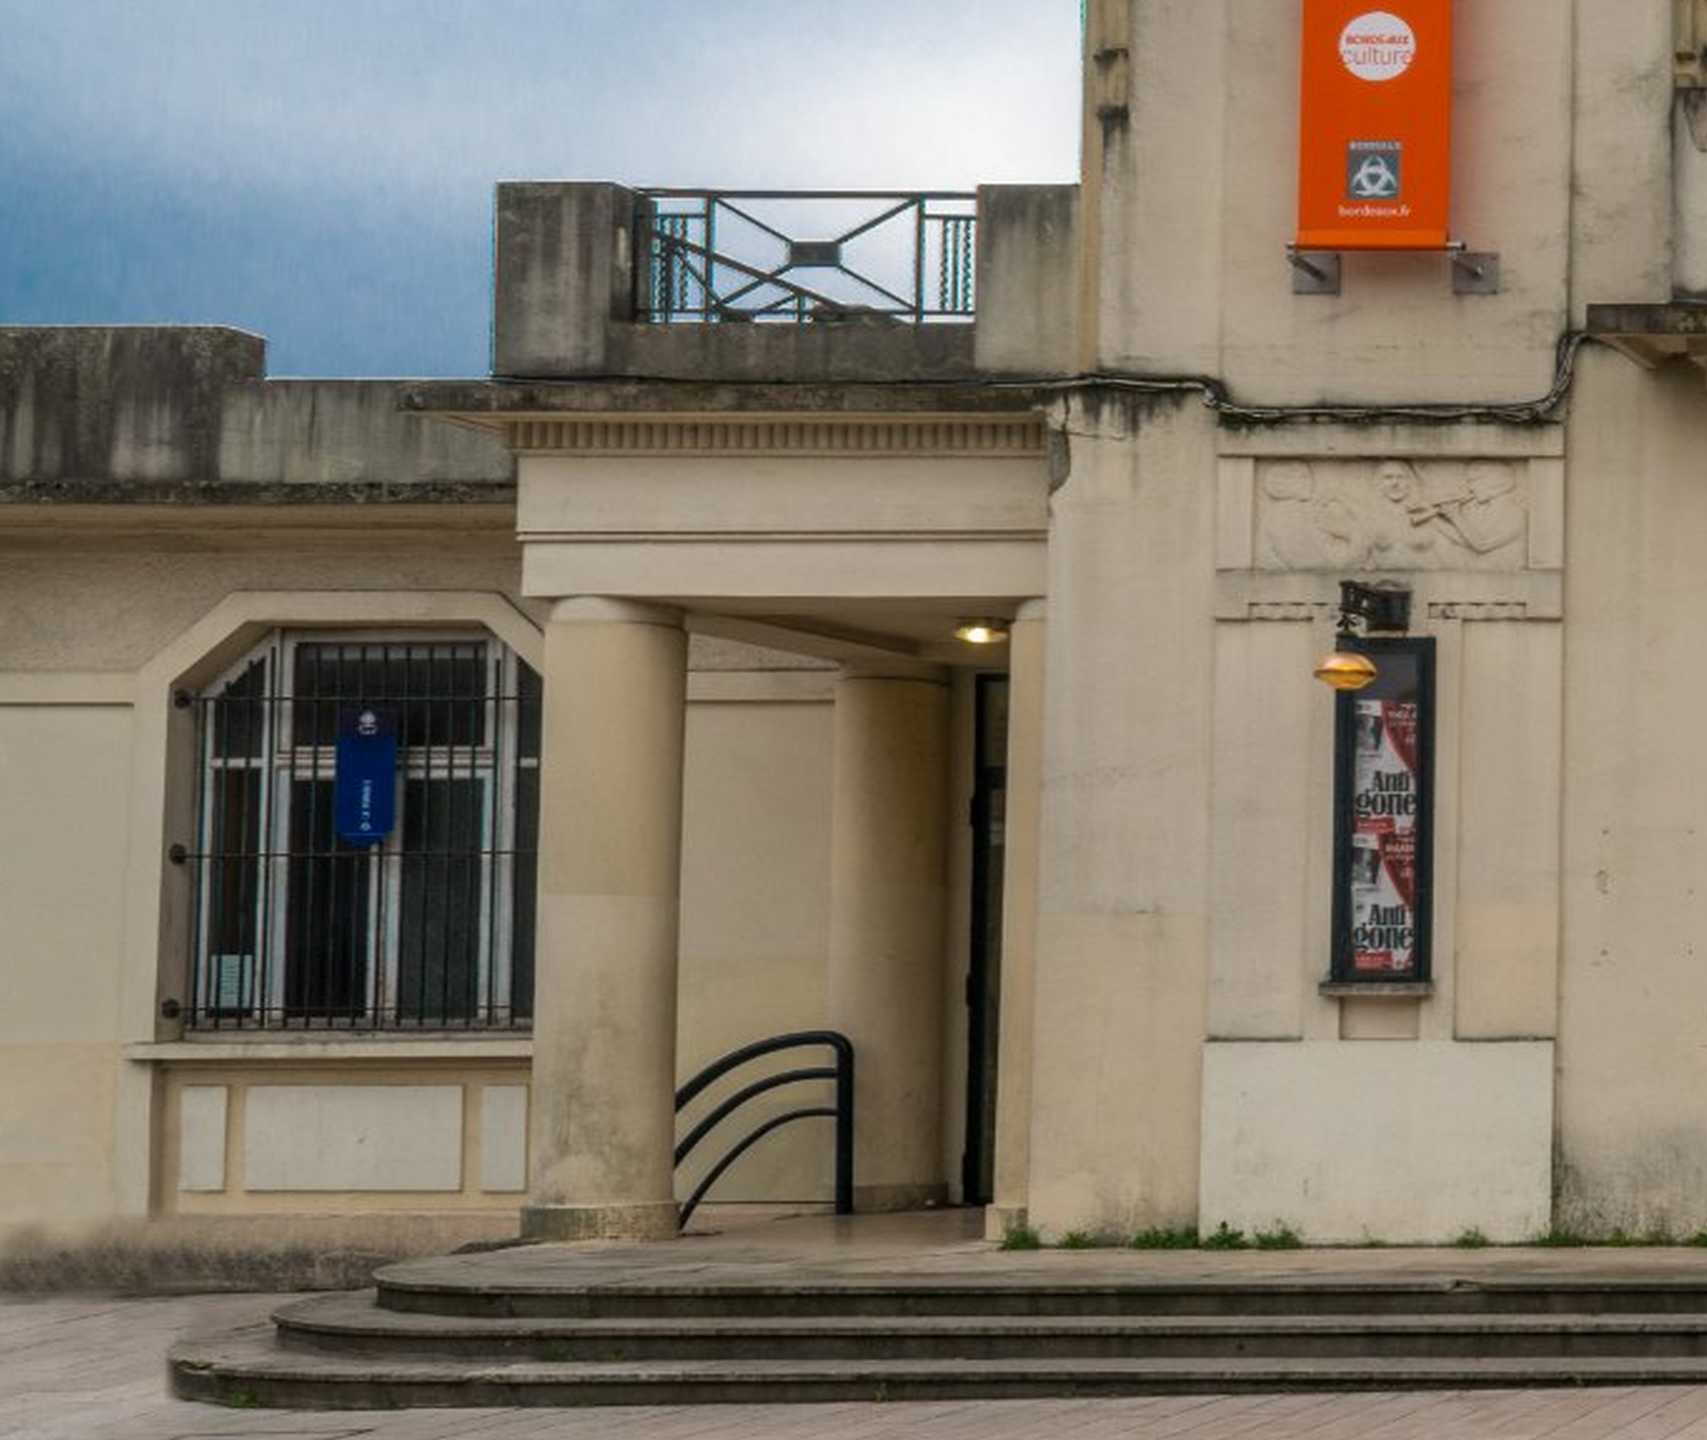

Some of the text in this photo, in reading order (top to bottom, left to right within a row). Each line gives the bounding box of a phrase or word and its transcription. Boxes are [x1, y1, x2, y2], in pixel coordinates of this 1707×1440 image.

[1342, 47, 1414, 65] culture
[1372, 769, 1408, 792] Anti
[1355, 789, 1416, 817] gone
[1369, 903, 1405, 926] Anti
[1354, 923, 1414, 951] gone
